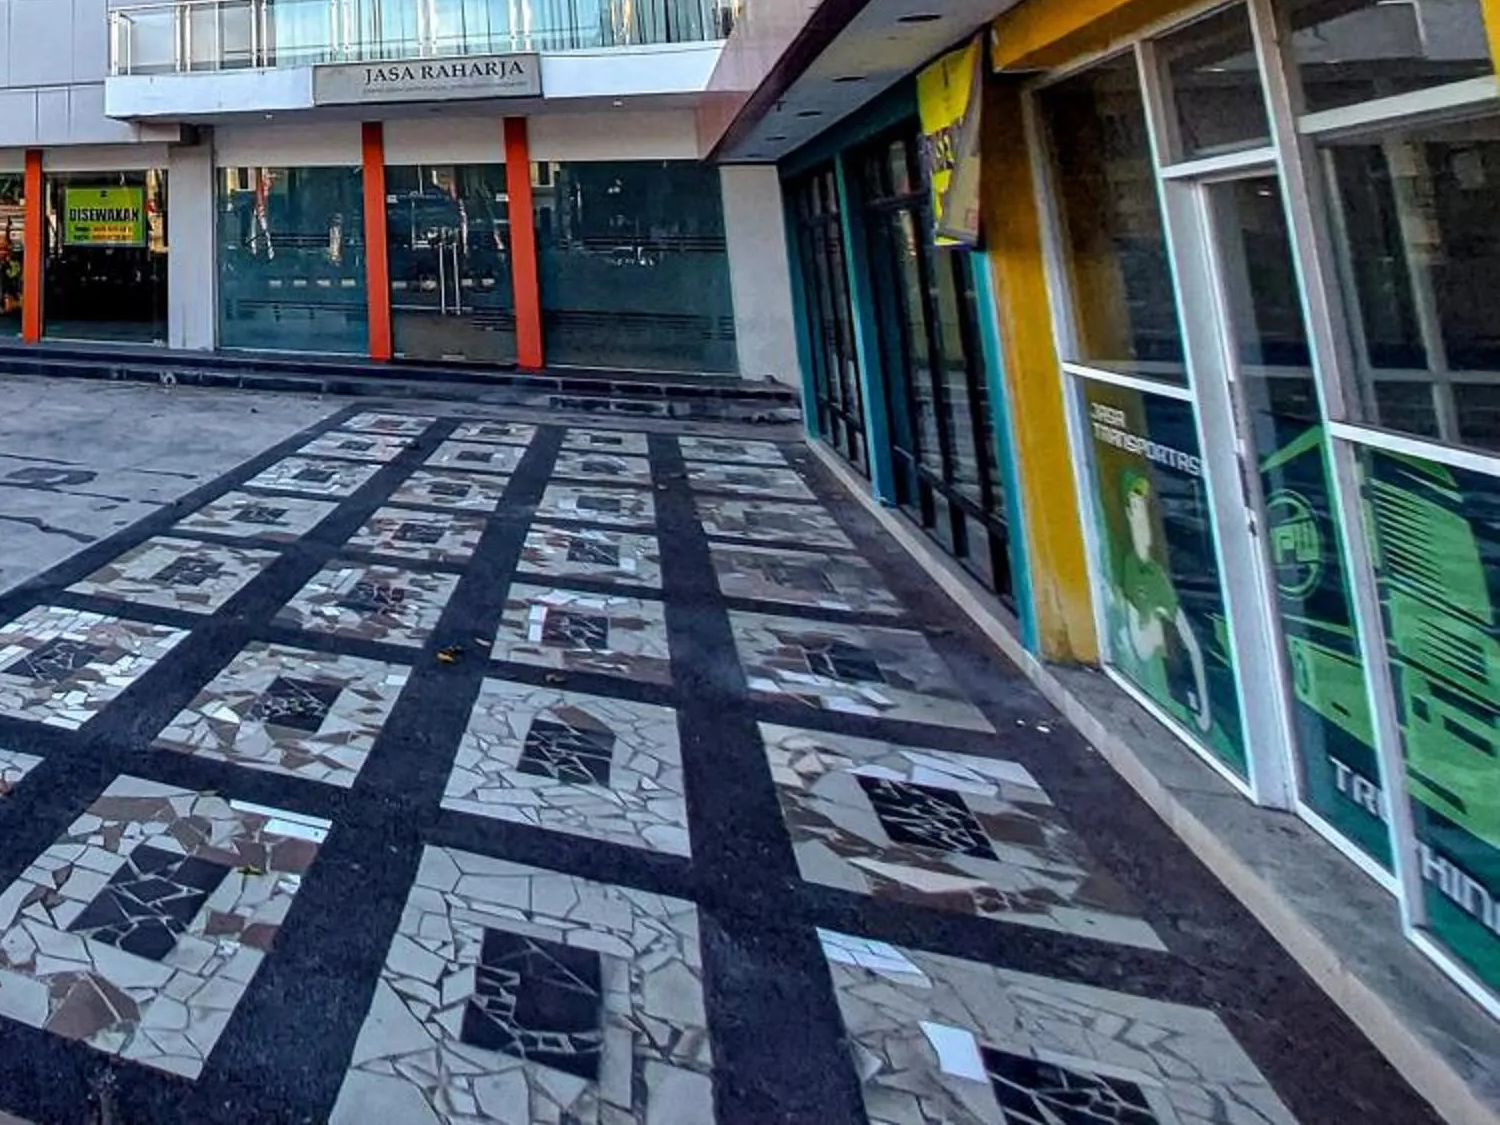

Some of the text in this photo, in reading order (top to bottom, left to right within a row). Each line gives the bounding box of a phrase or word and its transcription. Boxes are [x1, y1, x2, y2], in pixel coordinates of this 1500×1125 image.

[365, 60, 524, 85] JASA RAHARJA
[69, 207, 139, 221] DISEWAKAN
[1420, 842, 1500, 937] HIN
